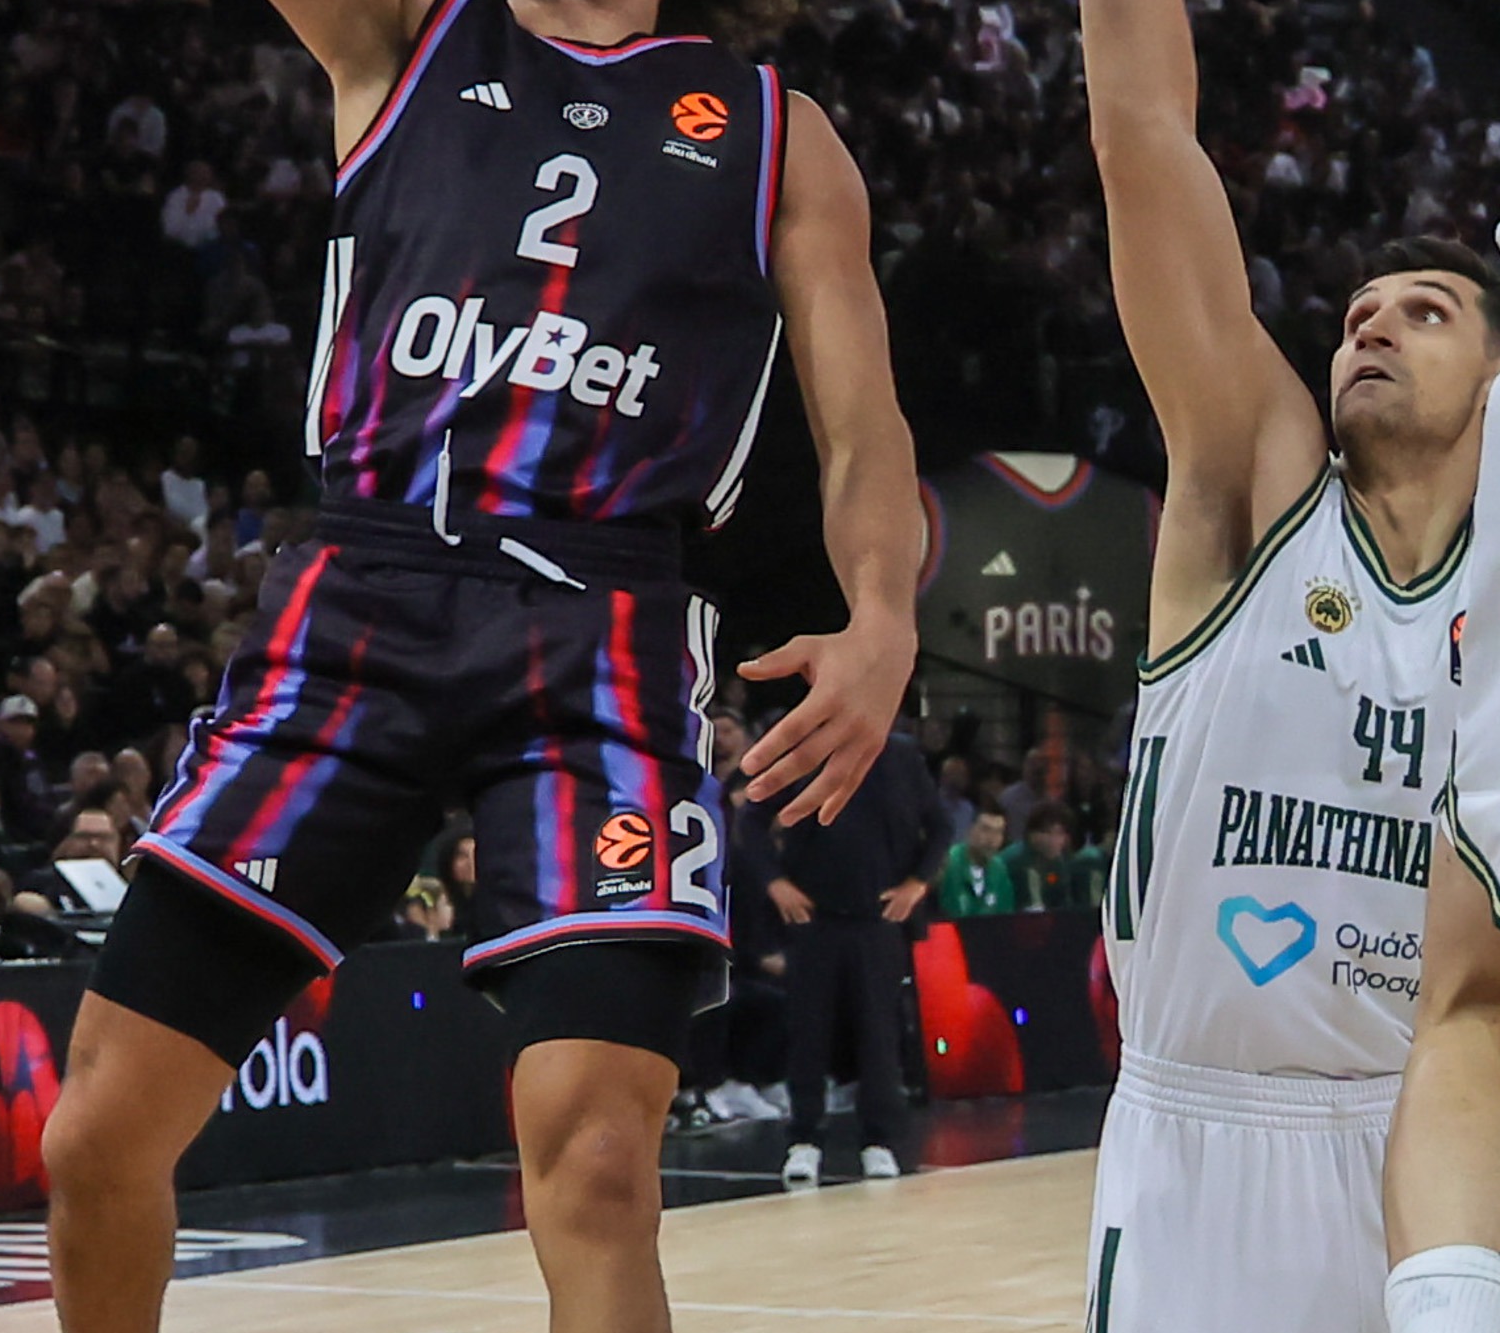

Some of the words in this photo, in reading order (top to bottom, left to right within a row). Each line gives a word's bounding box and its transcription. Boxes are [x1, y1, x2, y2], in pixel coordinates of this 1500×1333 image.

[516, 153, 600, 268] 2
[390, 296, 661, 419] OlyBet
[1353, 694, 1427, 790] 44
[669, 799, 718, 915] 2
[1336, 922, 1423, 960] Ομάδ
